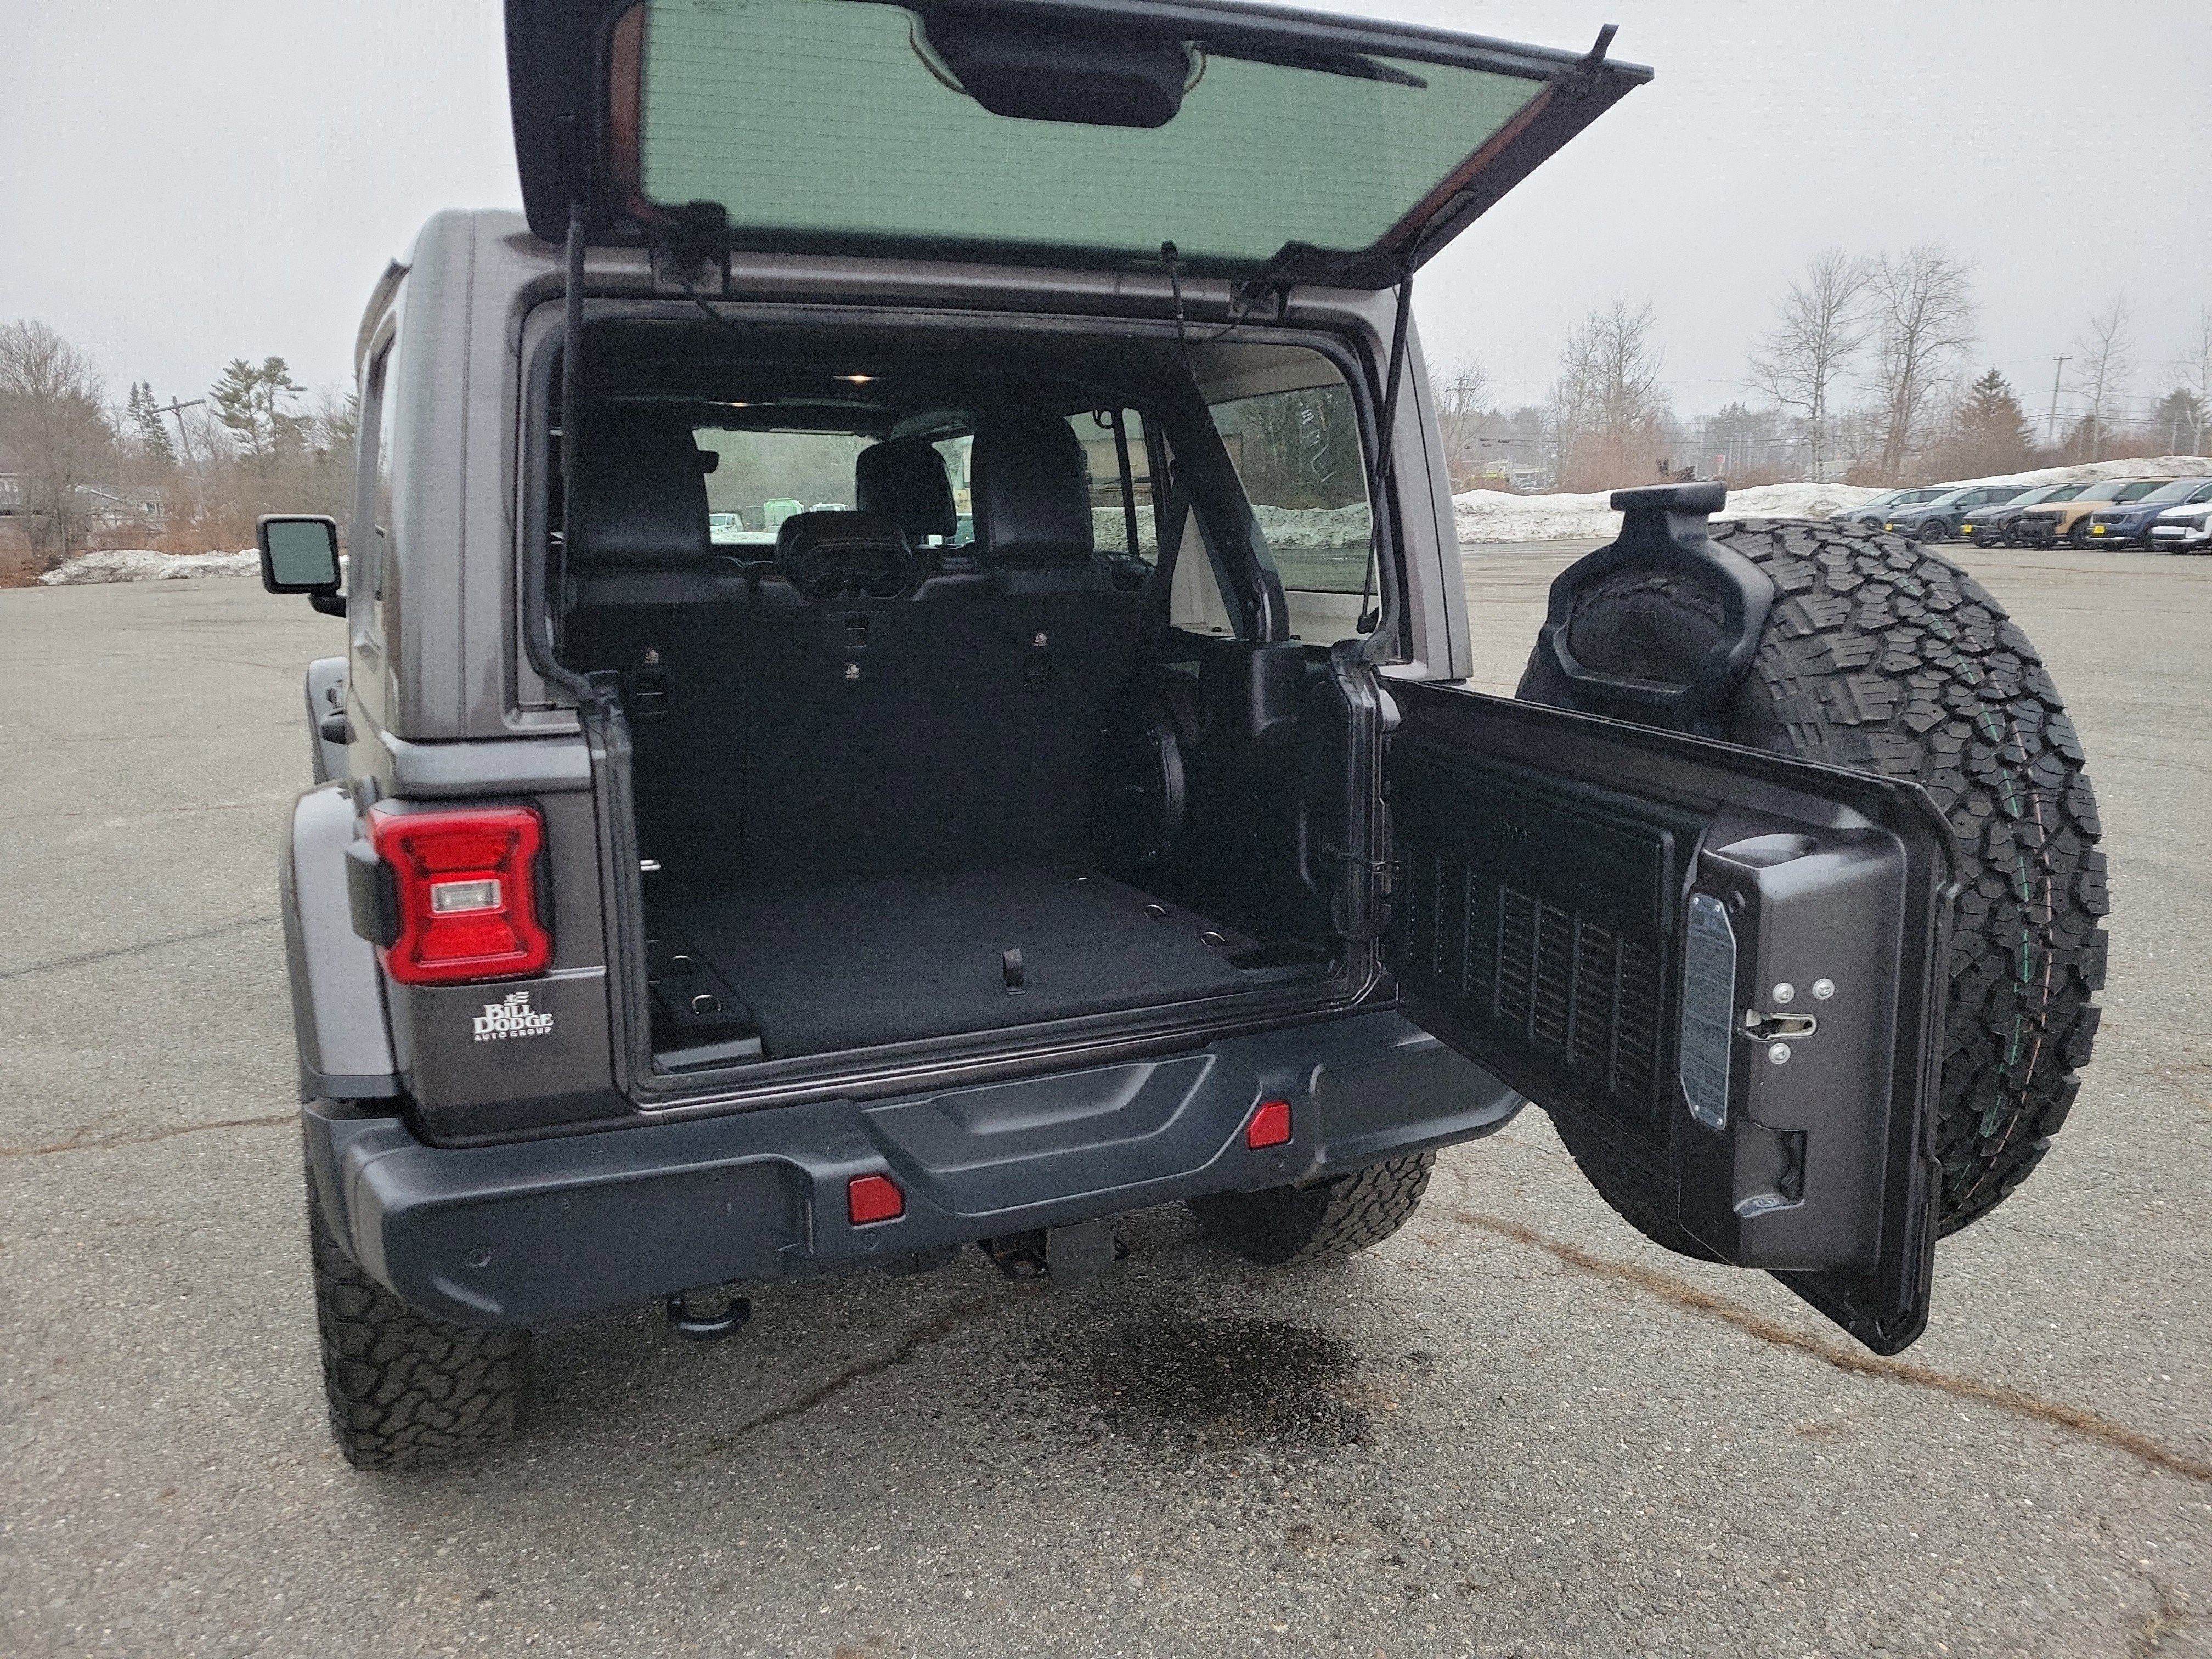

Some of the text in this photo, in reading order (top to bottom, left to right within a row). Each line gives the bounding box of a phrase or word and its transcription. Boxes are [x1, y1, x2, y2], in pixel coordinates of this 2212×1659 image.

[483, 1003, 537, 1020] BILL
[472, 1013, 555, 1034] DODGE
[474, 1026, 552, 1041] AUTO GROUP
